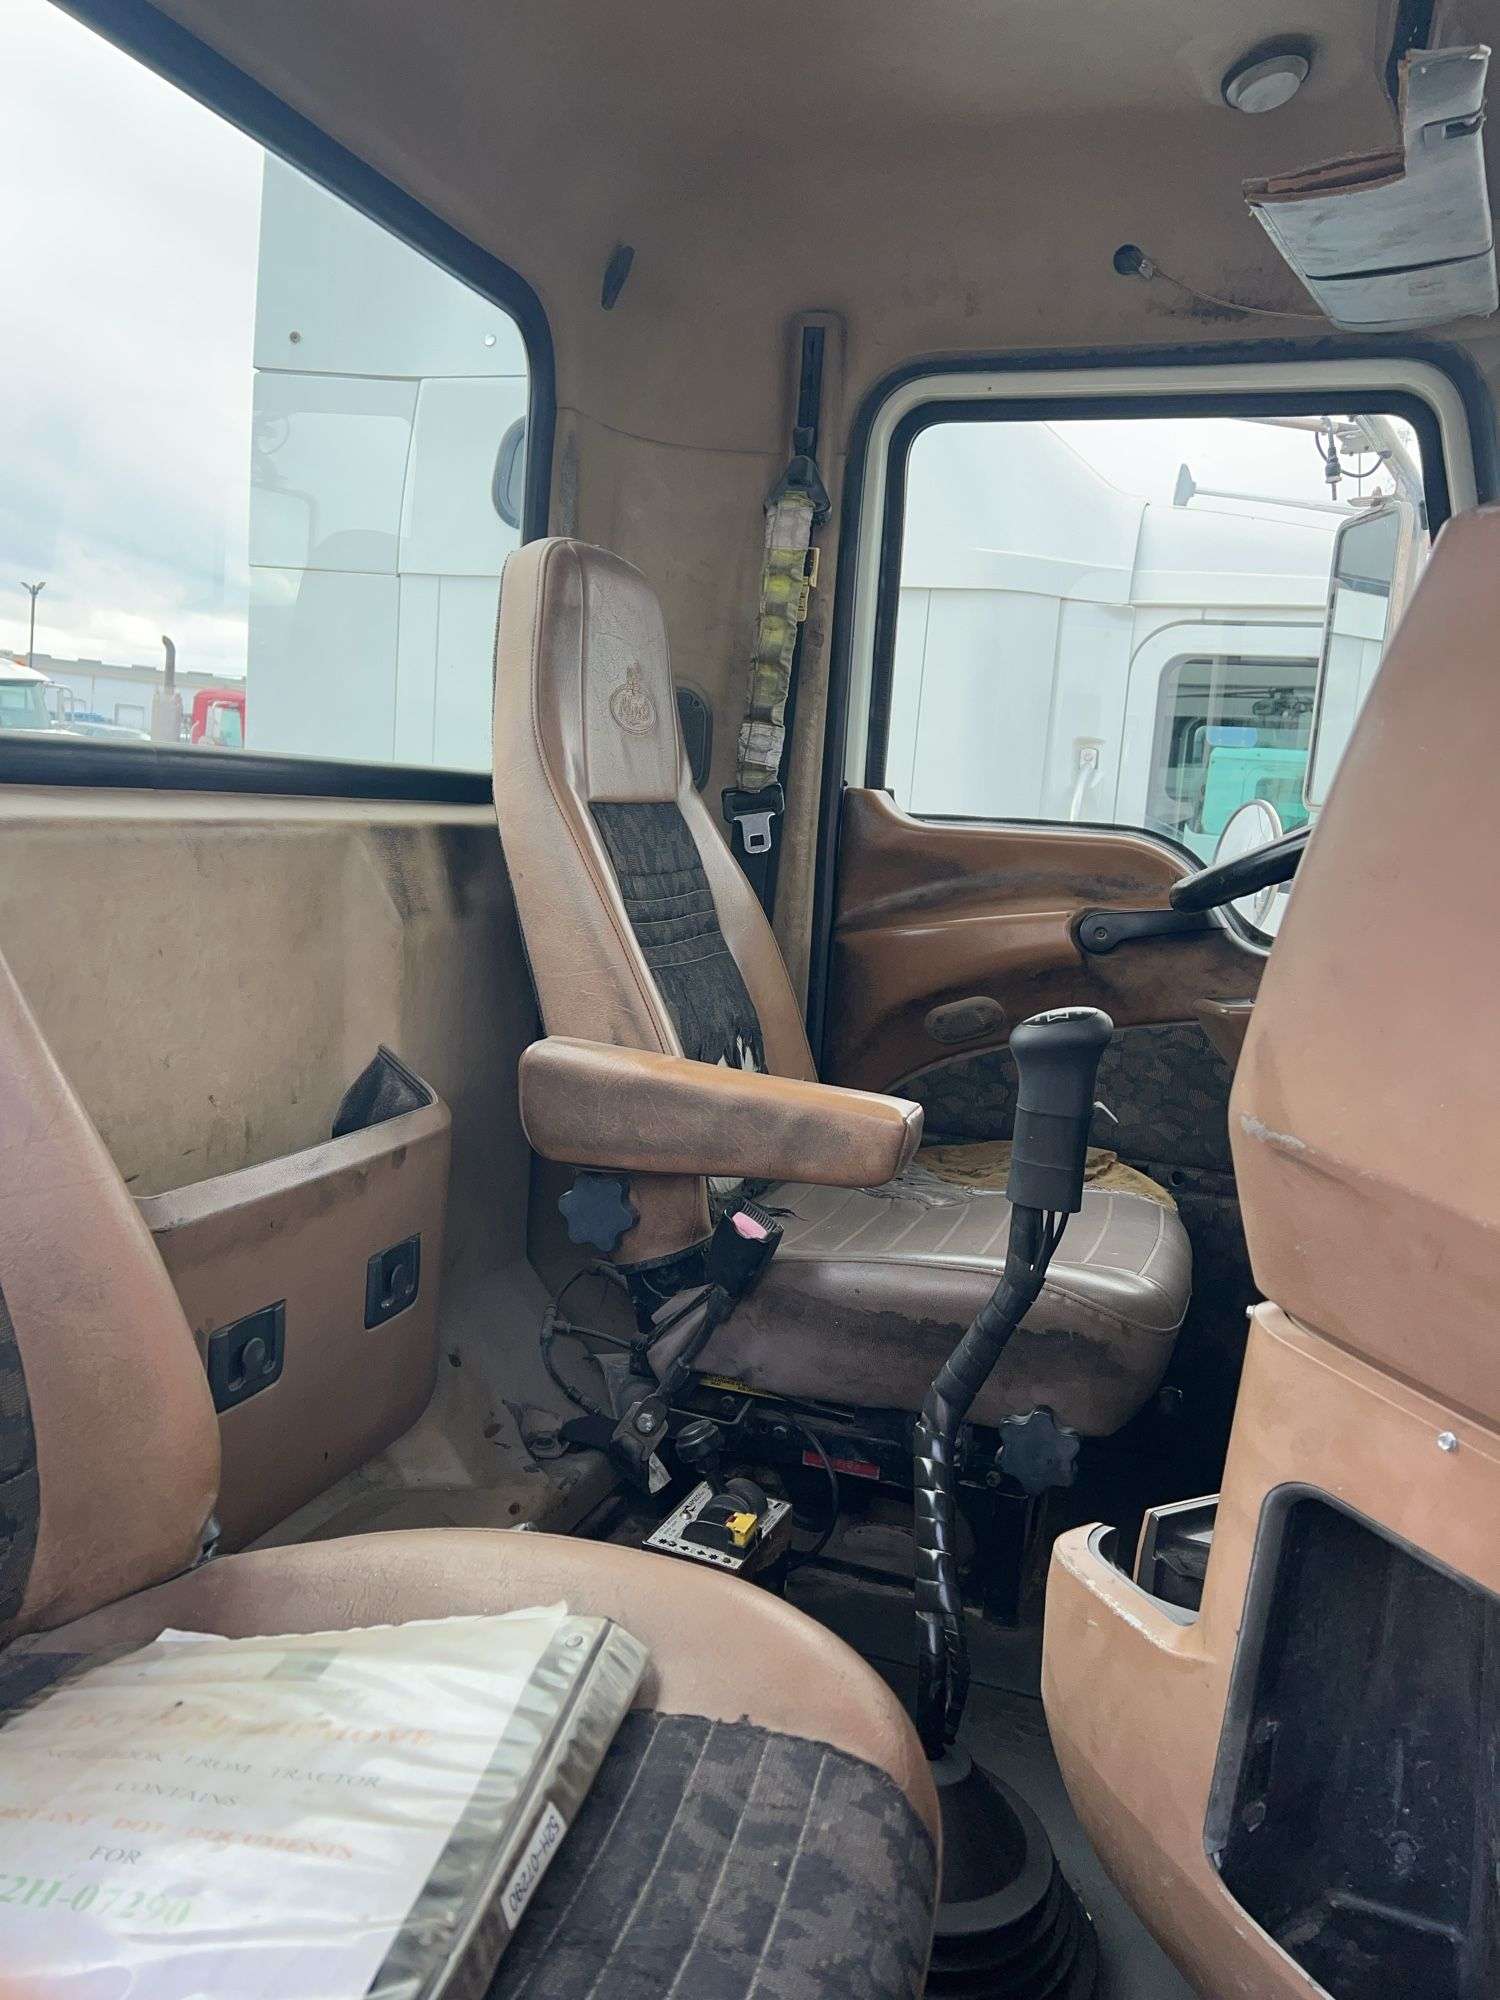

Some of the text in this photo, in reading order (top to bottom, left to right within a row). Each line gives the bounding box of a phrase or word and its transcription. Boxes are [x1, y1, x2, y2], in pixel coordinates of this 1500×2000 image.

[184, 1754, 252, 1774] FROM
[271, 1766, 381, 1789] TRACTOR
[113, 1781, 239, 1807] CONTAINS
[89, 1846, 141, 1865] FOR
[184, 1826, 353, 1860] DOCUMENTS
[0, 1874, 192, 1928] 2H-07290
